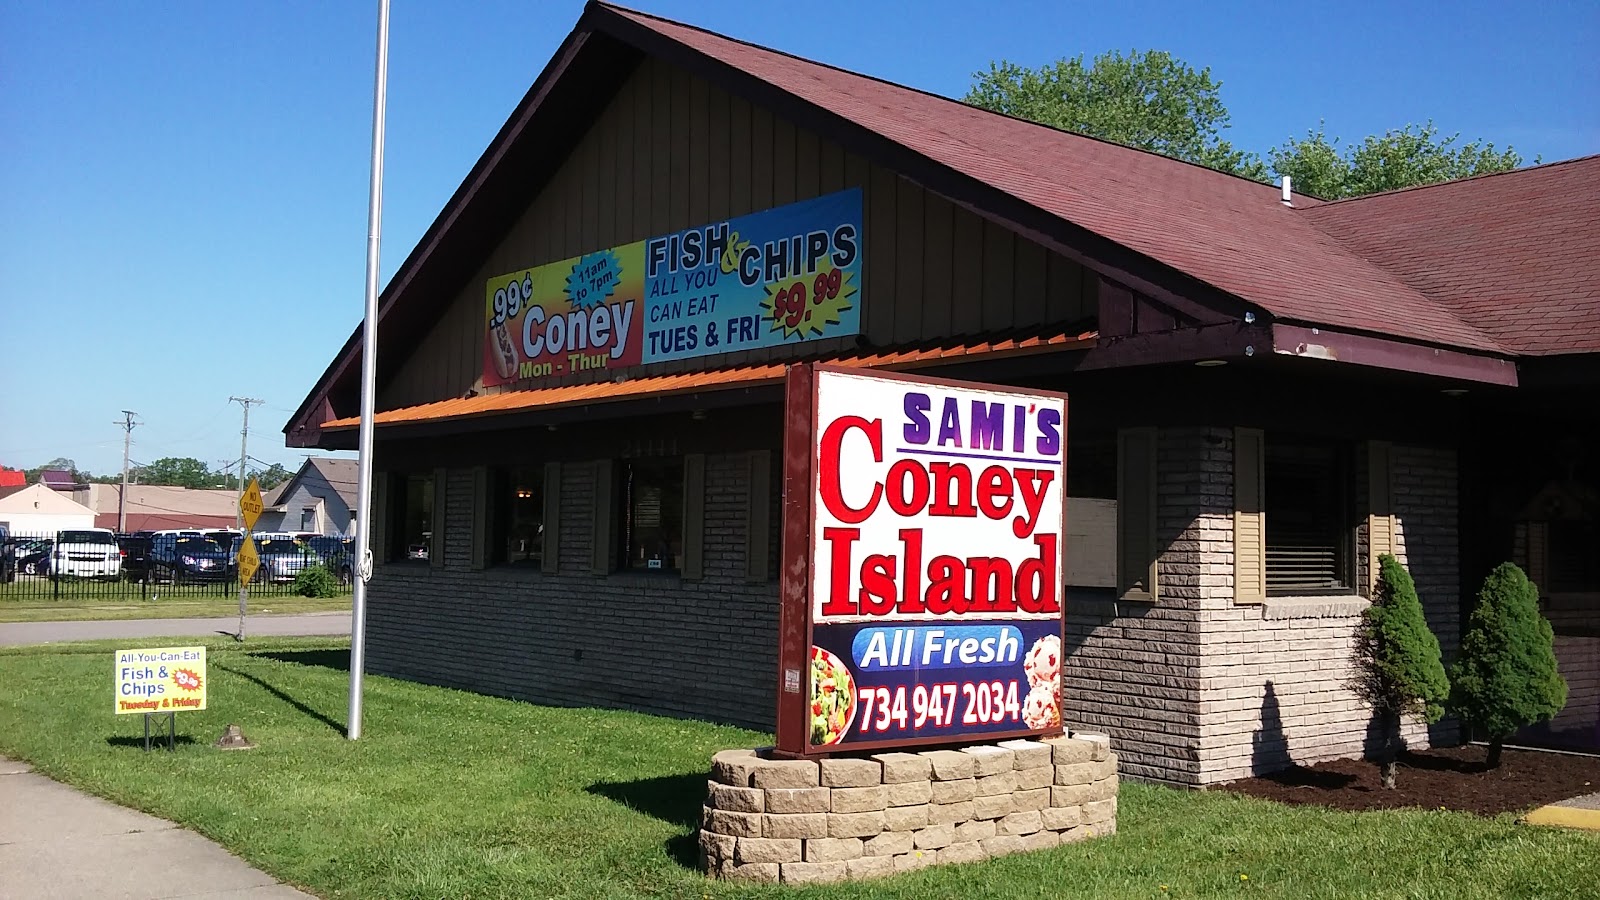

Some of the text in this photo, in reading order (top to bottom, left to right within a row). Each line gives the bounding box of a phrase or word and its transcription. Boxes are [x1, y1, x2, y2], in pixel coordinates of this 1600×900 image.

[649, 222, 857, 287] FISH & CHIPS
[579, 258, 607, 283] 11am
[650, 268, 718, 298] ALL YOU
[576, 271, 613, 301] to 7pm
[650, 294, 719, 323] CAN EAT
[522, 299, 635, 359] Coney
[649, 314, 760, 355] TUES & FRI
[519, 362, 553, 379] Mon
[568, 353, 609, 372] Thur
[903, 392, 1061, 456] SAMI'S
[819, 415, 1055, 538] Coney
[243, 501, 260, 514] OUTLET
[249, 492, 256, 501] NO
[822, 527, 1061, 616] Island
[120, 651, 200, 663] All-You-Can-Eat
[860, 627, 1019, 667] All Fresh
[122, 666, 168, 680] Fish &
[120, 697, 201, 710] Tuesday & Friday
[121, 682, 165, 697] Chips
[859, 681, 1020, 732] 734 947 2034
